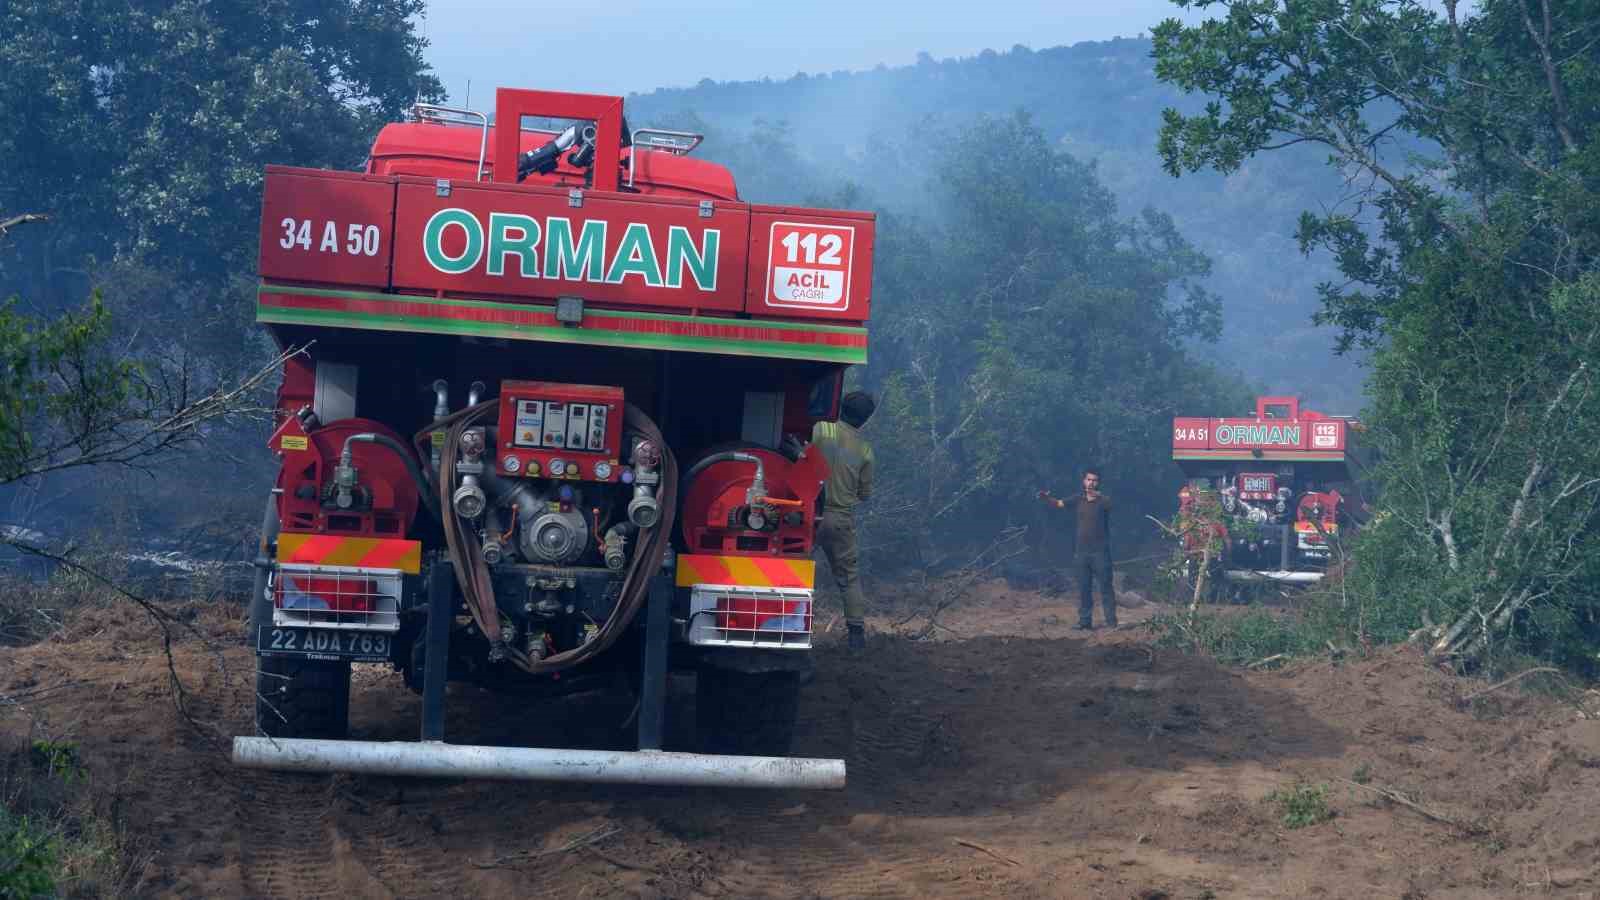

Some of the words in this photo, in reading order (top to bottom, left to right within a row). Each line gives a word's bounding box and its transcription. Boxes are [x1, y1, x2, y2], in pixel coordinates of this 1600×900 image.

[280, 218, 312, 250] 34
[319, 221, 338, 253] A
[346, 224, 380, 256] 50
[781, 231, 843, 265] 112
[423, 208, 721, 291] ORMAN
[787, 271, 830, 288] ACİL
[1175, 427, 1187, 441] 34
[1188, 428, 1196, 441] A
[1198, 428, 1208, 441] 51
[1215, 424, 1300, 445] ORMAN
[1316, 425, 1336, 435] 112
[271, 629, 297, 649] 22
[303, 632, 341, 651] ADA
[349, 633, 386, 653] 763
